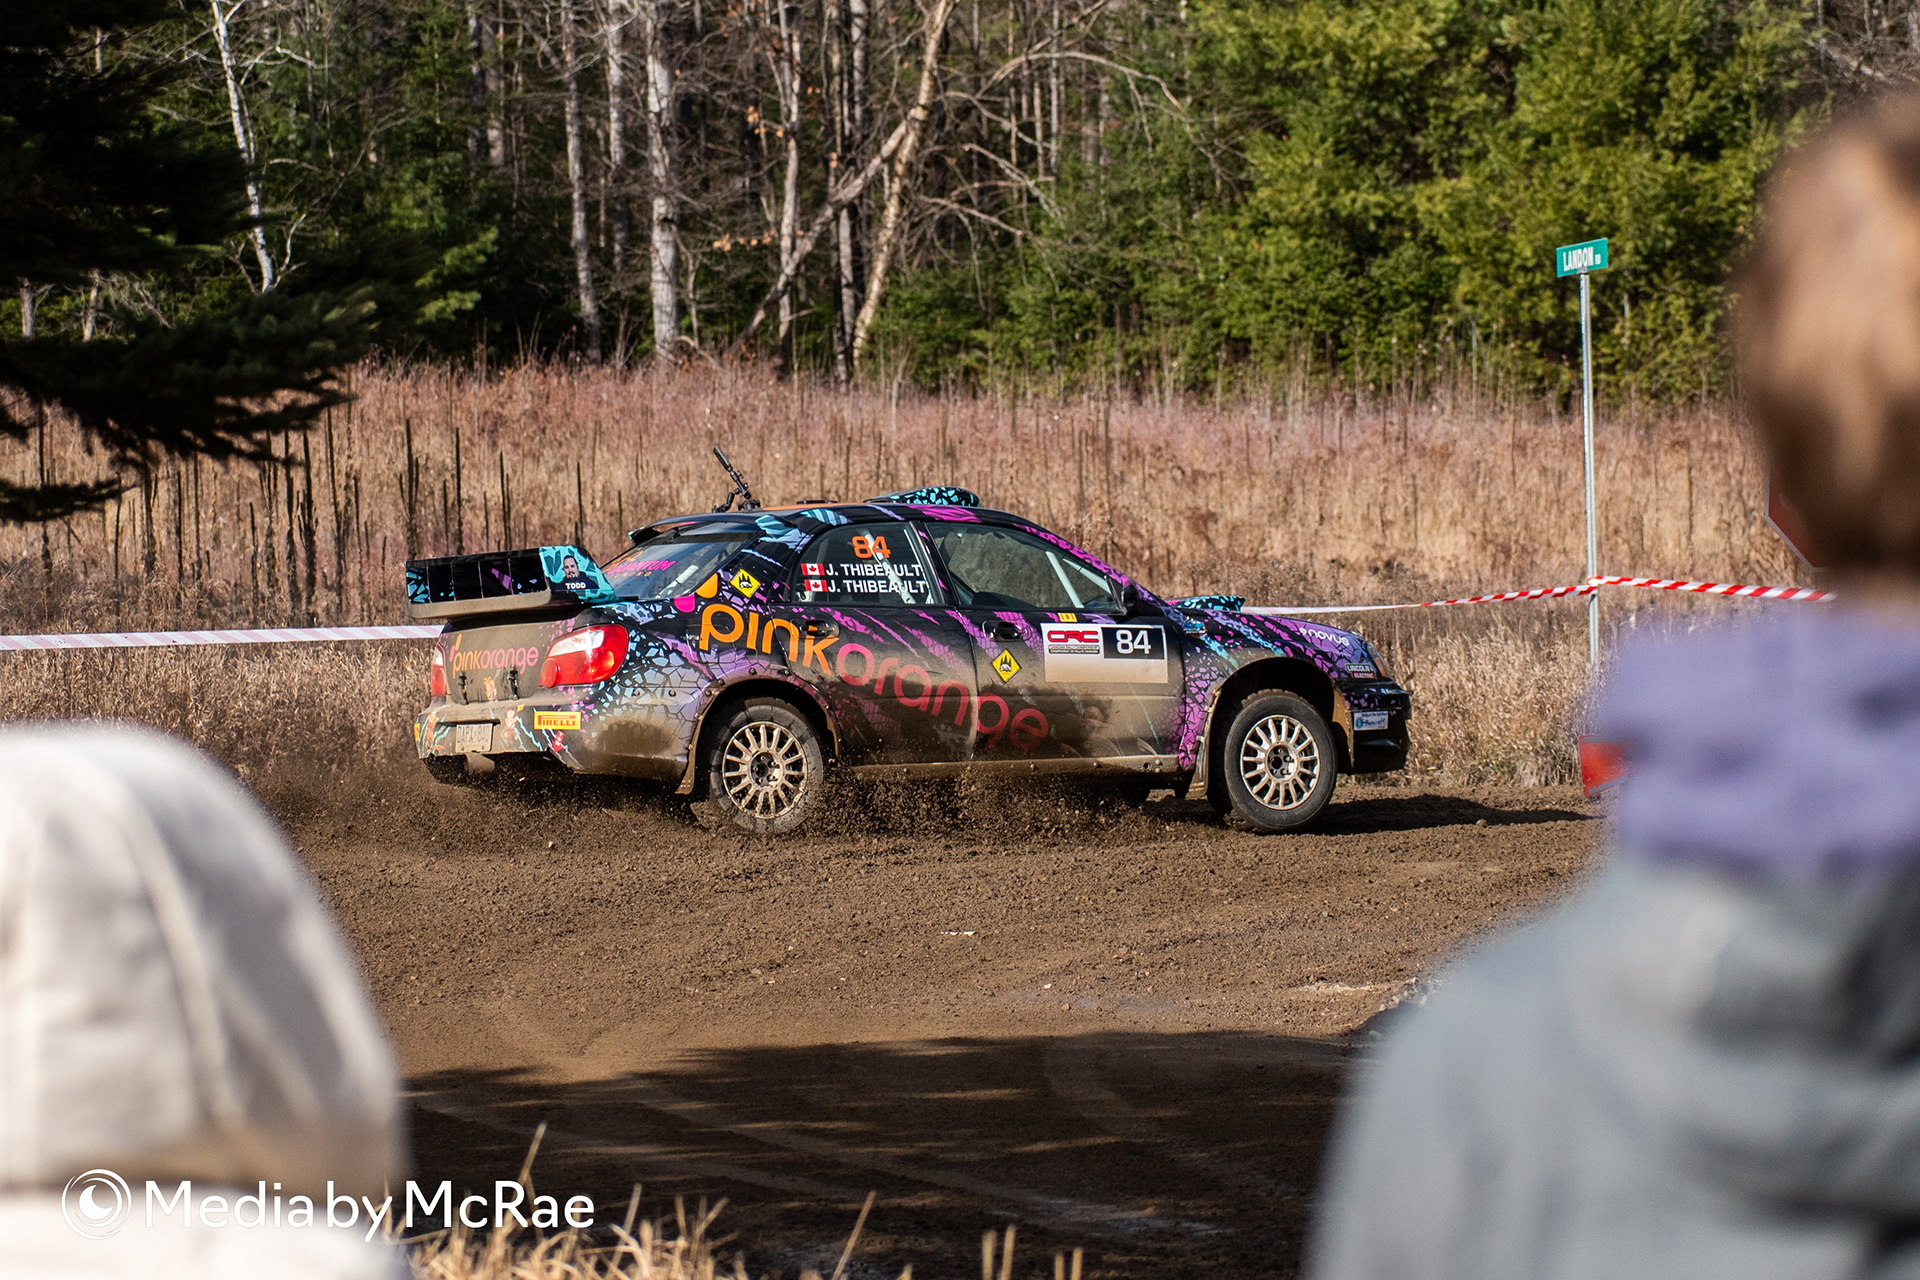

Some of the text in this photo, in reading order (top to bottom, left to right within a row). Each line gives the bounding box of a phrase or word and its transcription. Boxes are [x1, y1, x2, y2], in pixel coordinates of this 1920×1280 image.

[1563, 246, 1594, 271] LANDON
[852, 536, 891, 558] 84
[826, 563, 921, 577] J. THIBEAULT
[565, 582, 586, 590] TODD
[828, 579, 926, 593] J. THIBEAULT
[1047, 630, 1099, 643] CRC
[1116, 630, 1151, 654] 84
[453, 646, 539, 679] pinkorange
[1347, 664, 1370, 672] LINCOLN
[699, 603, 1049, 750] pinkorange
[538, 715, 576, 726] PIRELLI
